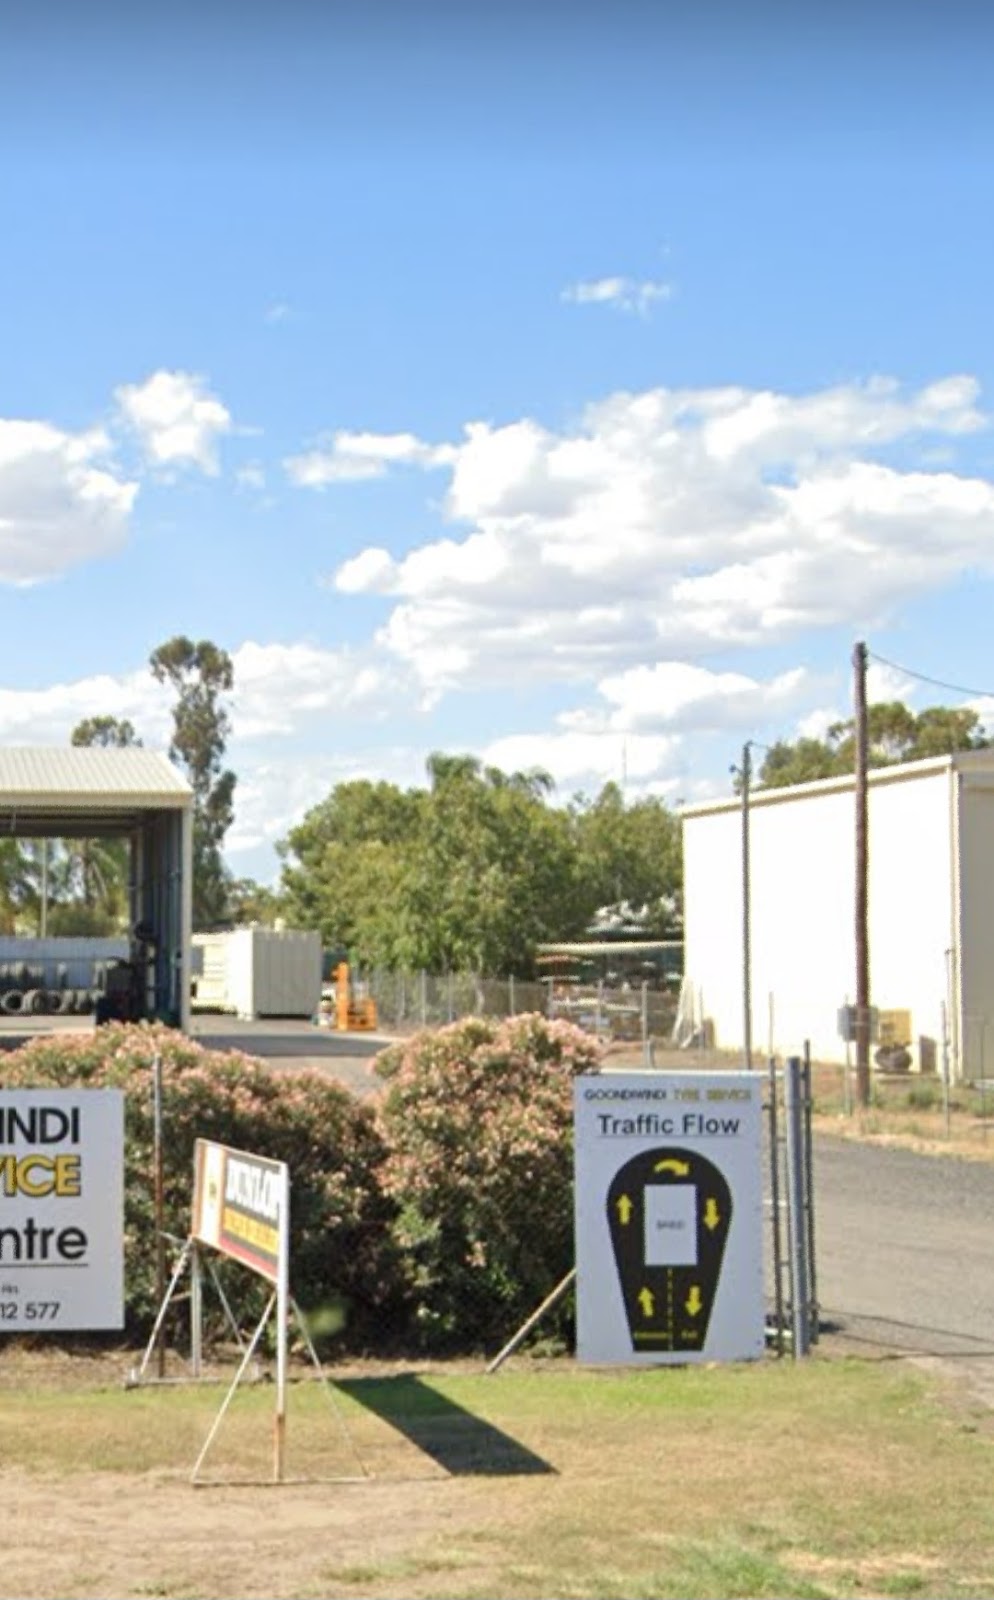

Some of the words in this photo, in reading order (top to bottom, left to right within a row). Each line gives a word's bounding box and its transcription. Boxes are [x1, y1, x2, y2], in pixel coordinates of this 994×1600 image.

[597, 1115, 674, 1134] Traffic
[682, 1114, 740, 1134] Flow
[0, 1154, 82, 1197] ICE
[25, 1302, 60, 1319] 577
